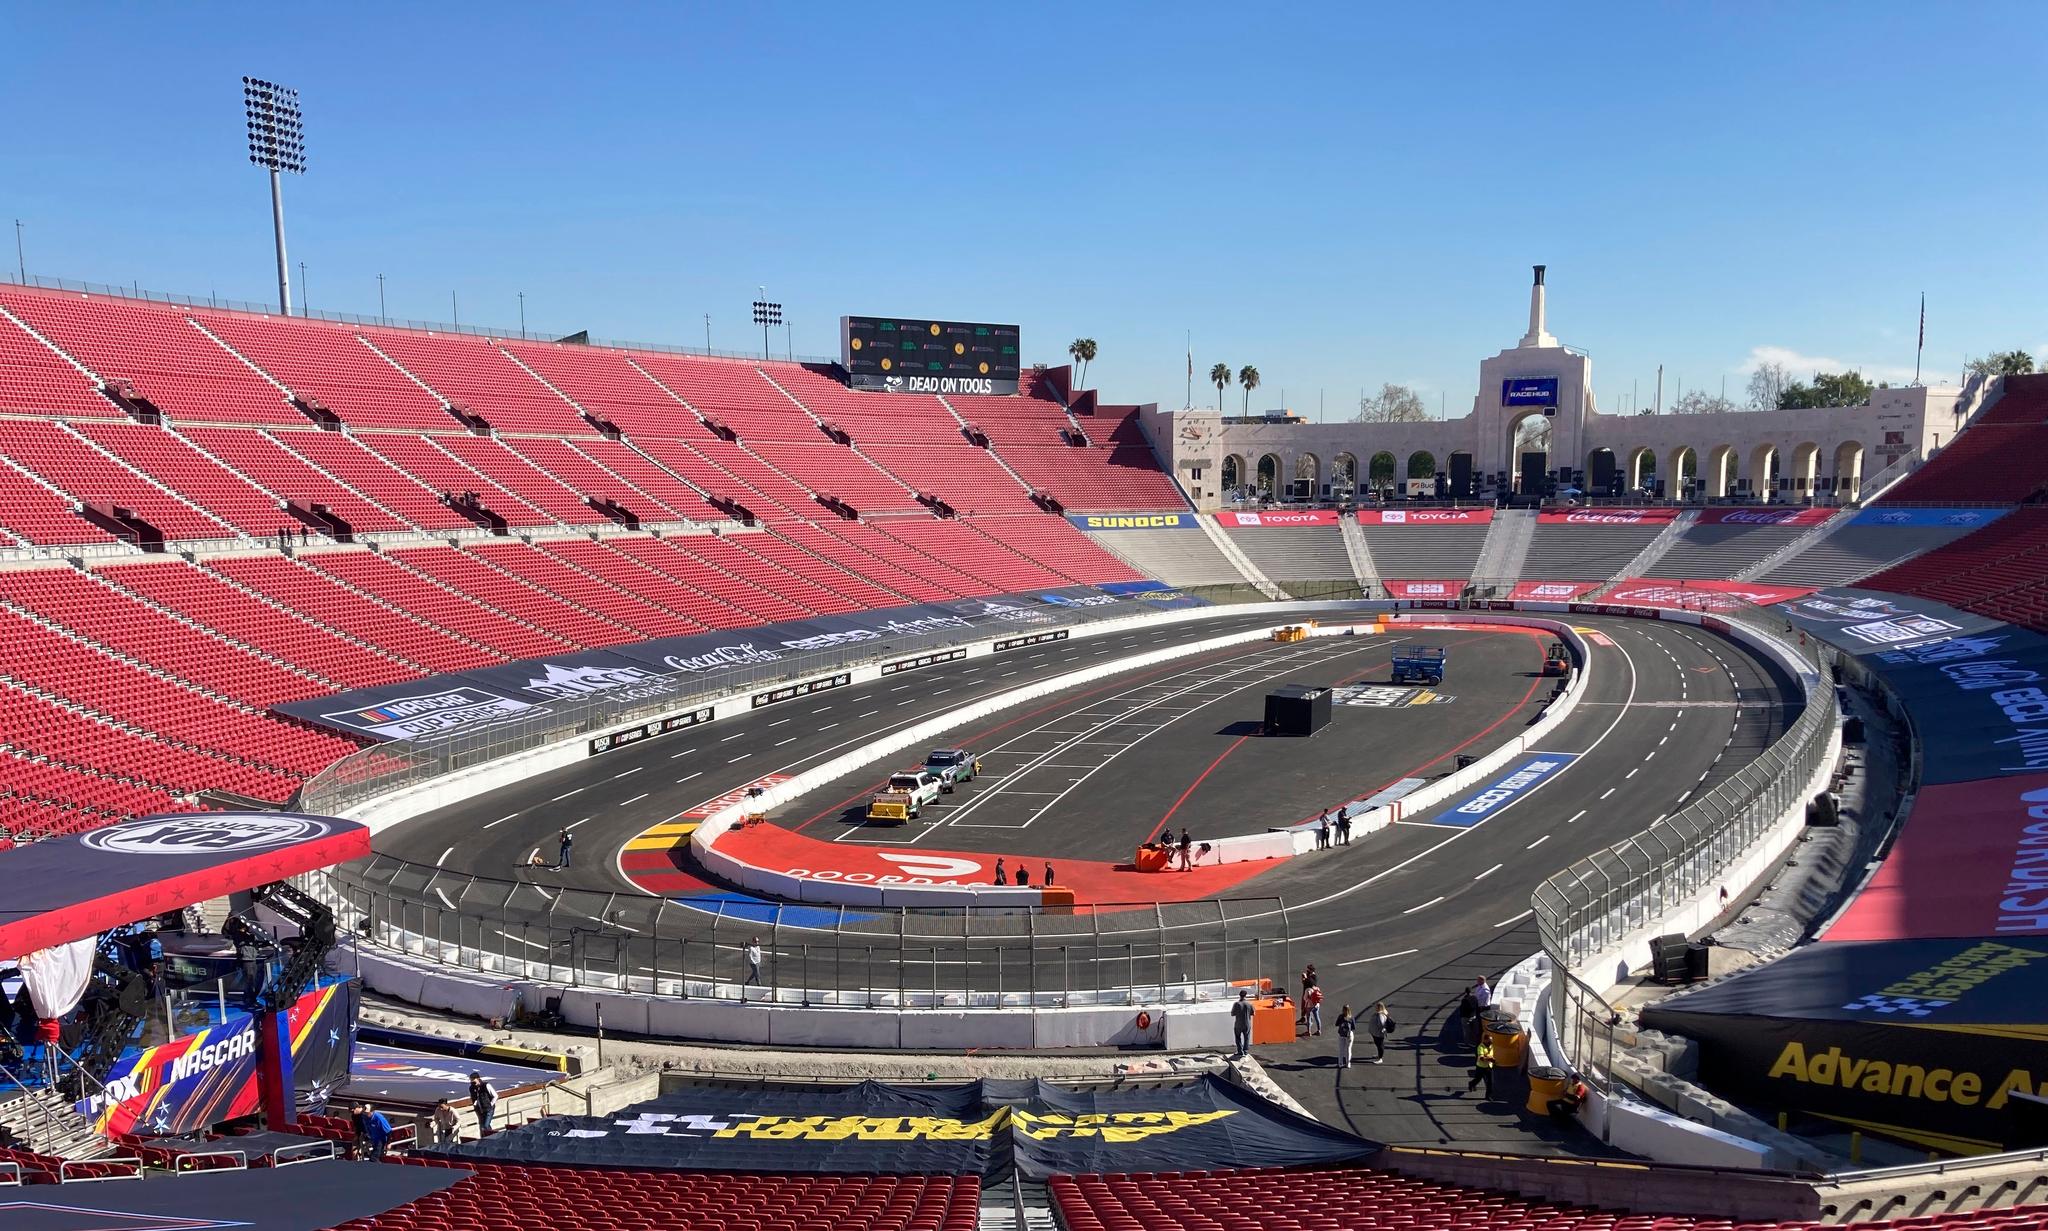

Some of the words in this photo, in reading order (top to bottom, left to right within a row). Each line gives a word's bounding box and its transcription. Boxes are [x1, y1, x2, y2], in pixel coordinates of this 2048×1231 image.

[909, 376, 939, 392] DEAD
[941, 377, 957, 393] ON
[958, 378, 992, 394] TOOLS
[1087, 515, 1179, 528] SUNOCO
[1264, 514, 1319, 523] TOYOTA
[1411, 512, 1469, 520] TOYOTA
[384, 694, 474, 717] NASCAR
[398, 718, 445, 735] CUP
[442, 704, 510, 726] SERIES
[1456, 789, 1514, 813] GEICO
[113, 826, 276, 848] FOX
[175, 820, 297, 834] SPORTS
[90, 1070, 142, 1114] FOX
[170, 1029, 256, 1082] NASCAR
[1768, 1041, 1983, 1106] Advance
